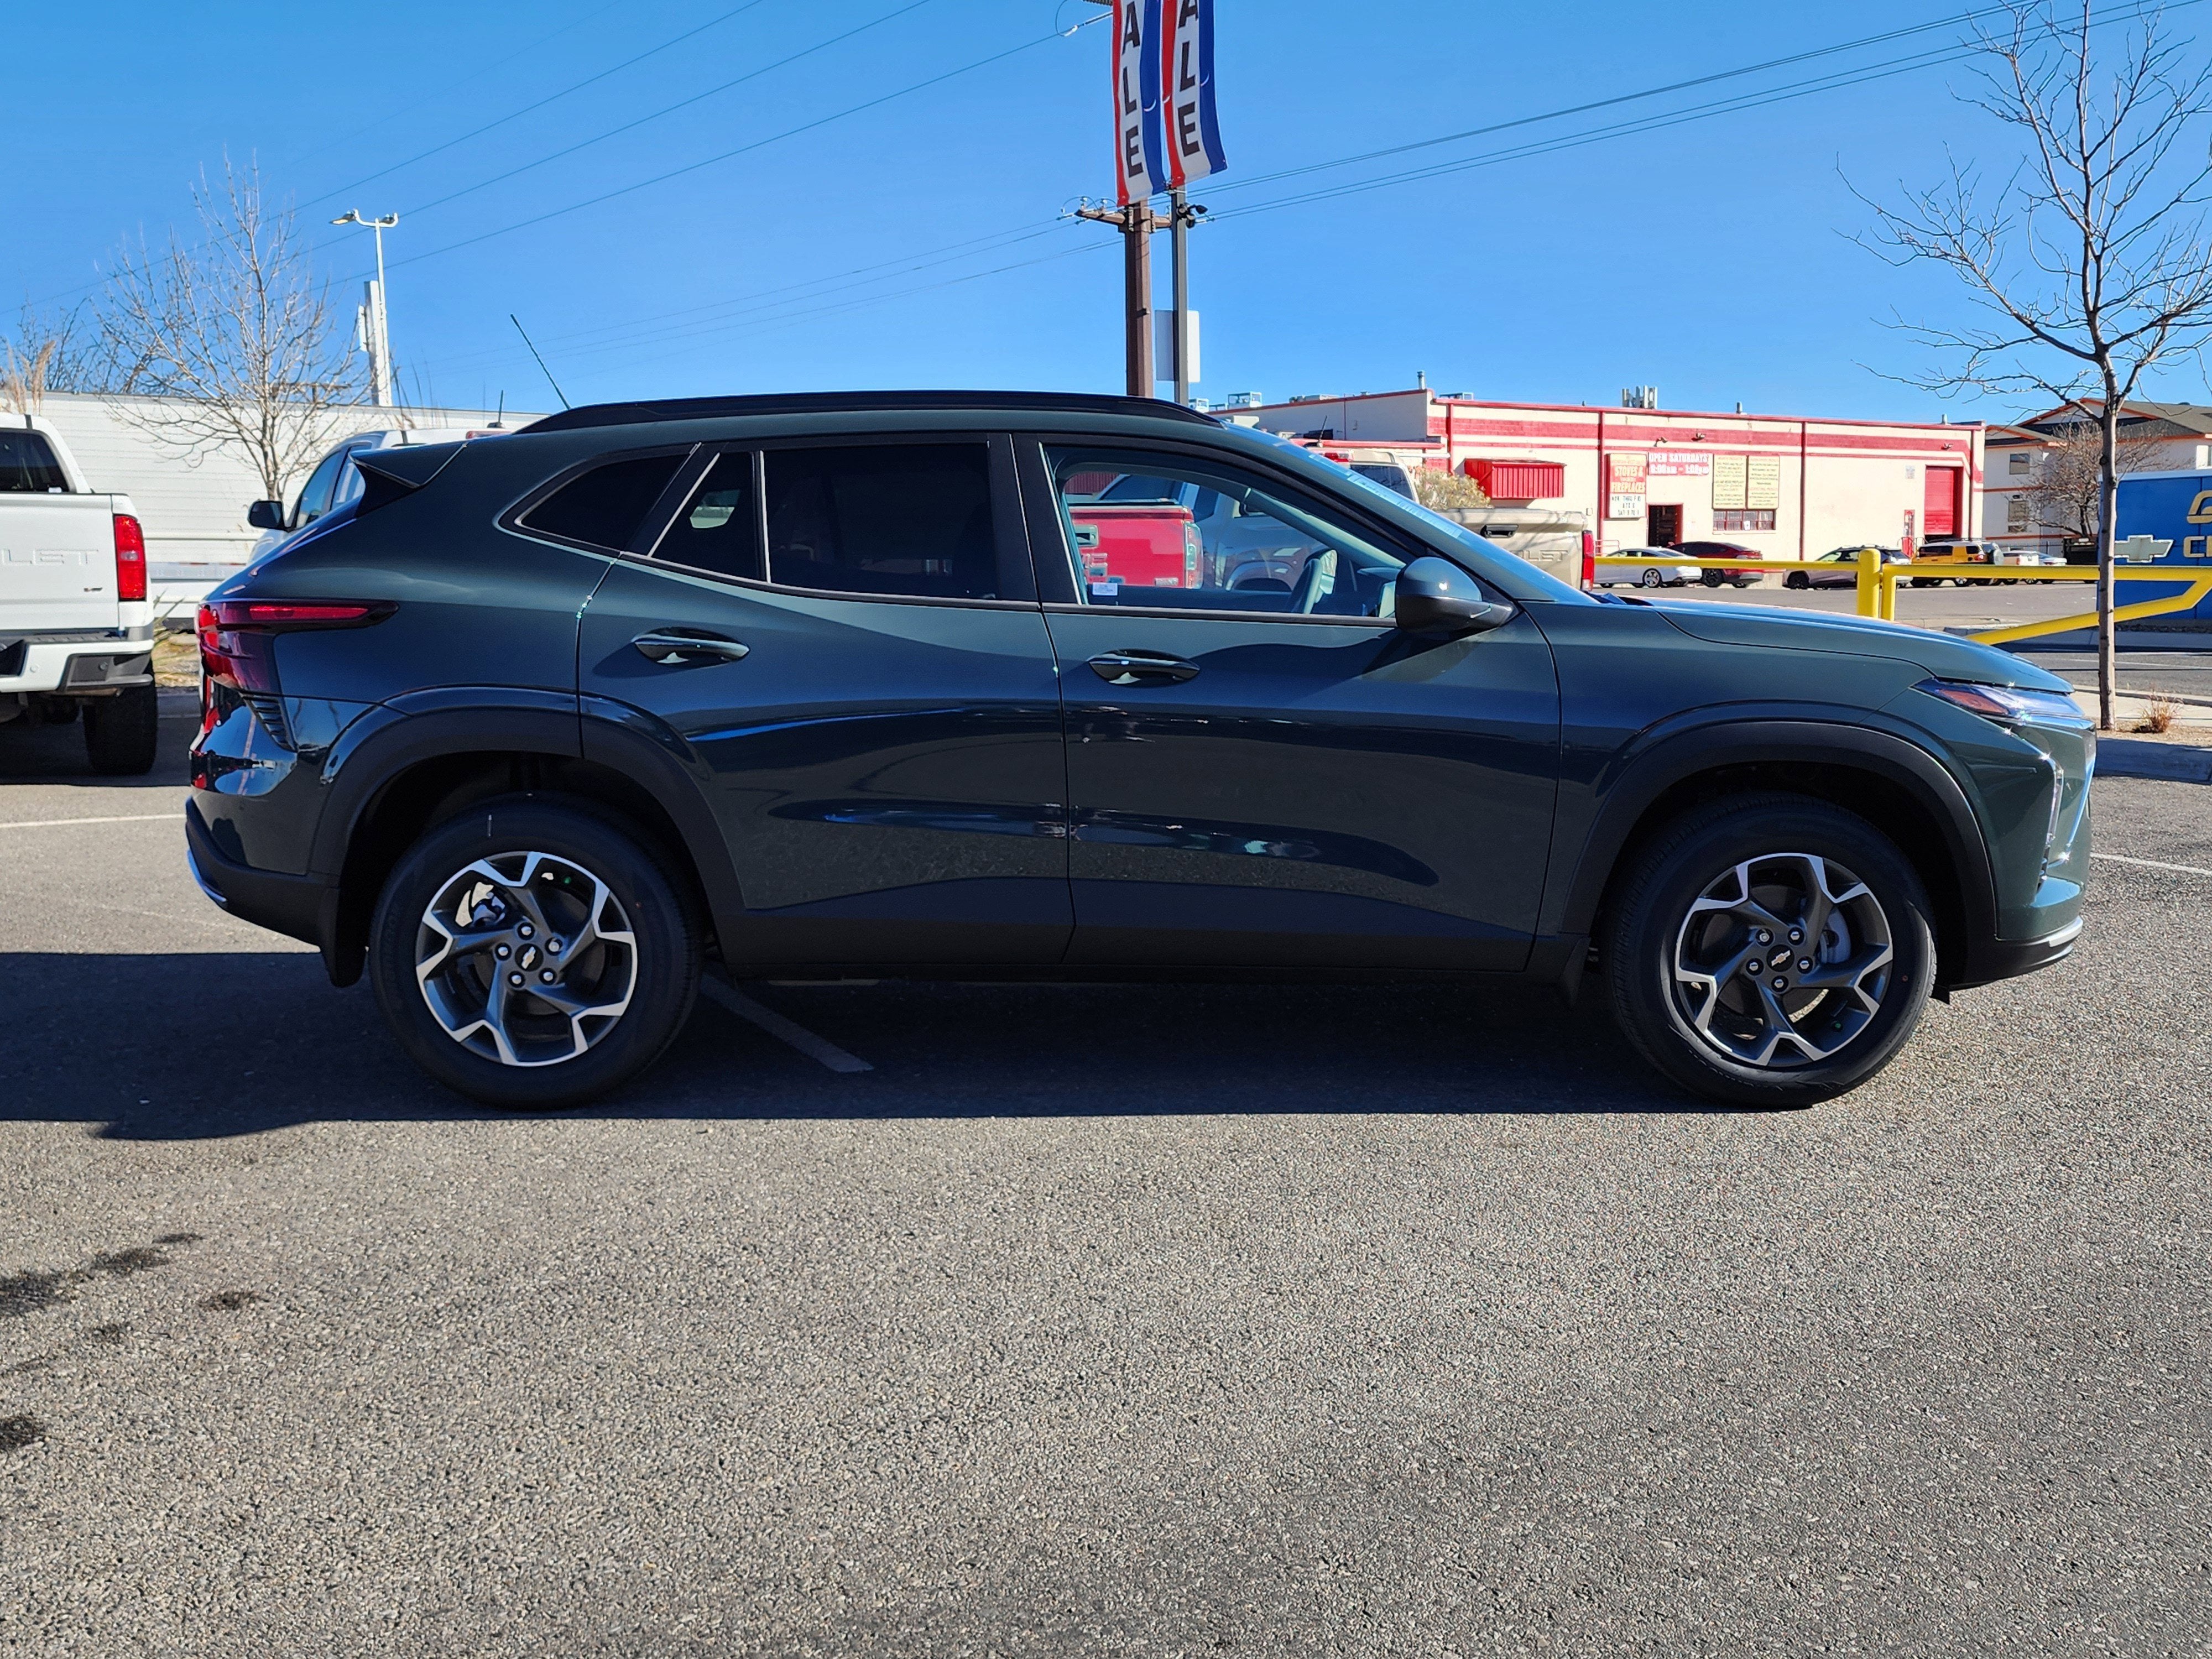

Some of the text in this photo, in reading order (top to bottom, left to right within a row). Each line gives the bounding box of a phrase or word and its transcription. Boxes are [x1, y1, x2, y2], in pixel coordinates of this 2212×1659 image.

[1648, 452, 1667, 462] OPEN
[1669, 452, 1709, 463] SATURDAYS
[1615, 466, 1638, 477] STOVES
[1611, 482, 1645, 493] FIREPLACES
